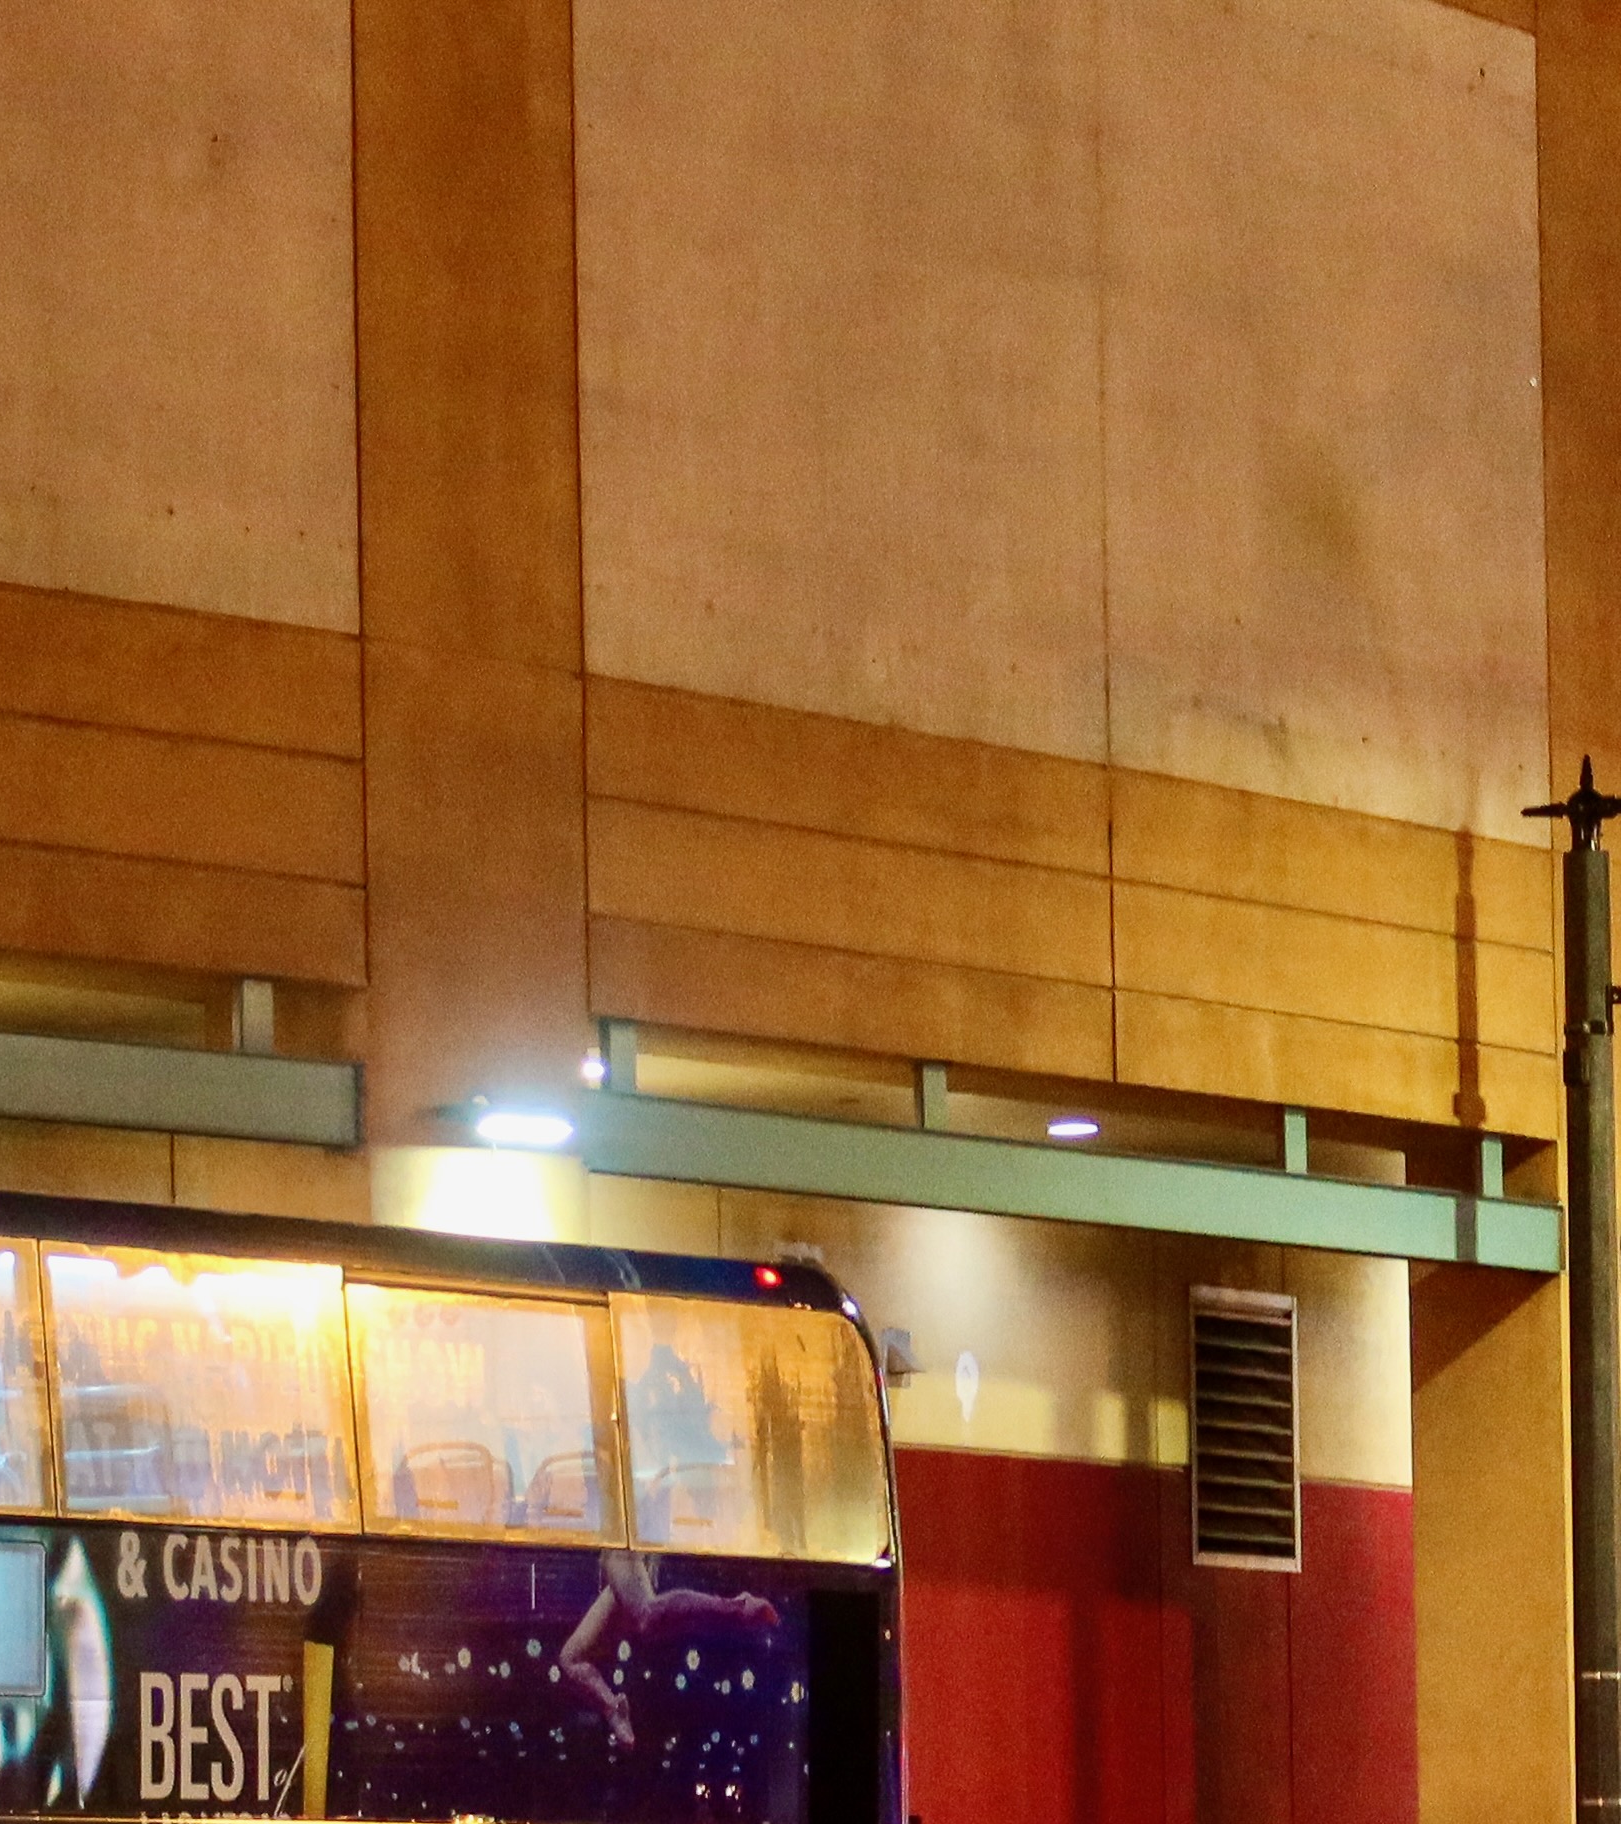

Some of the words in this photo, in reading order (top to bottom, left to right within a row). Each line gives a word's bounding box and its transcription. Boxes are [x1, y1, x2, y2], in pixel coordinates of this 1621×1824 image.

[117, 1530, 149, 1599] &
[162, 1532, 324, 1606] CASINO
[139, 1671, 283, 1802] BEST
